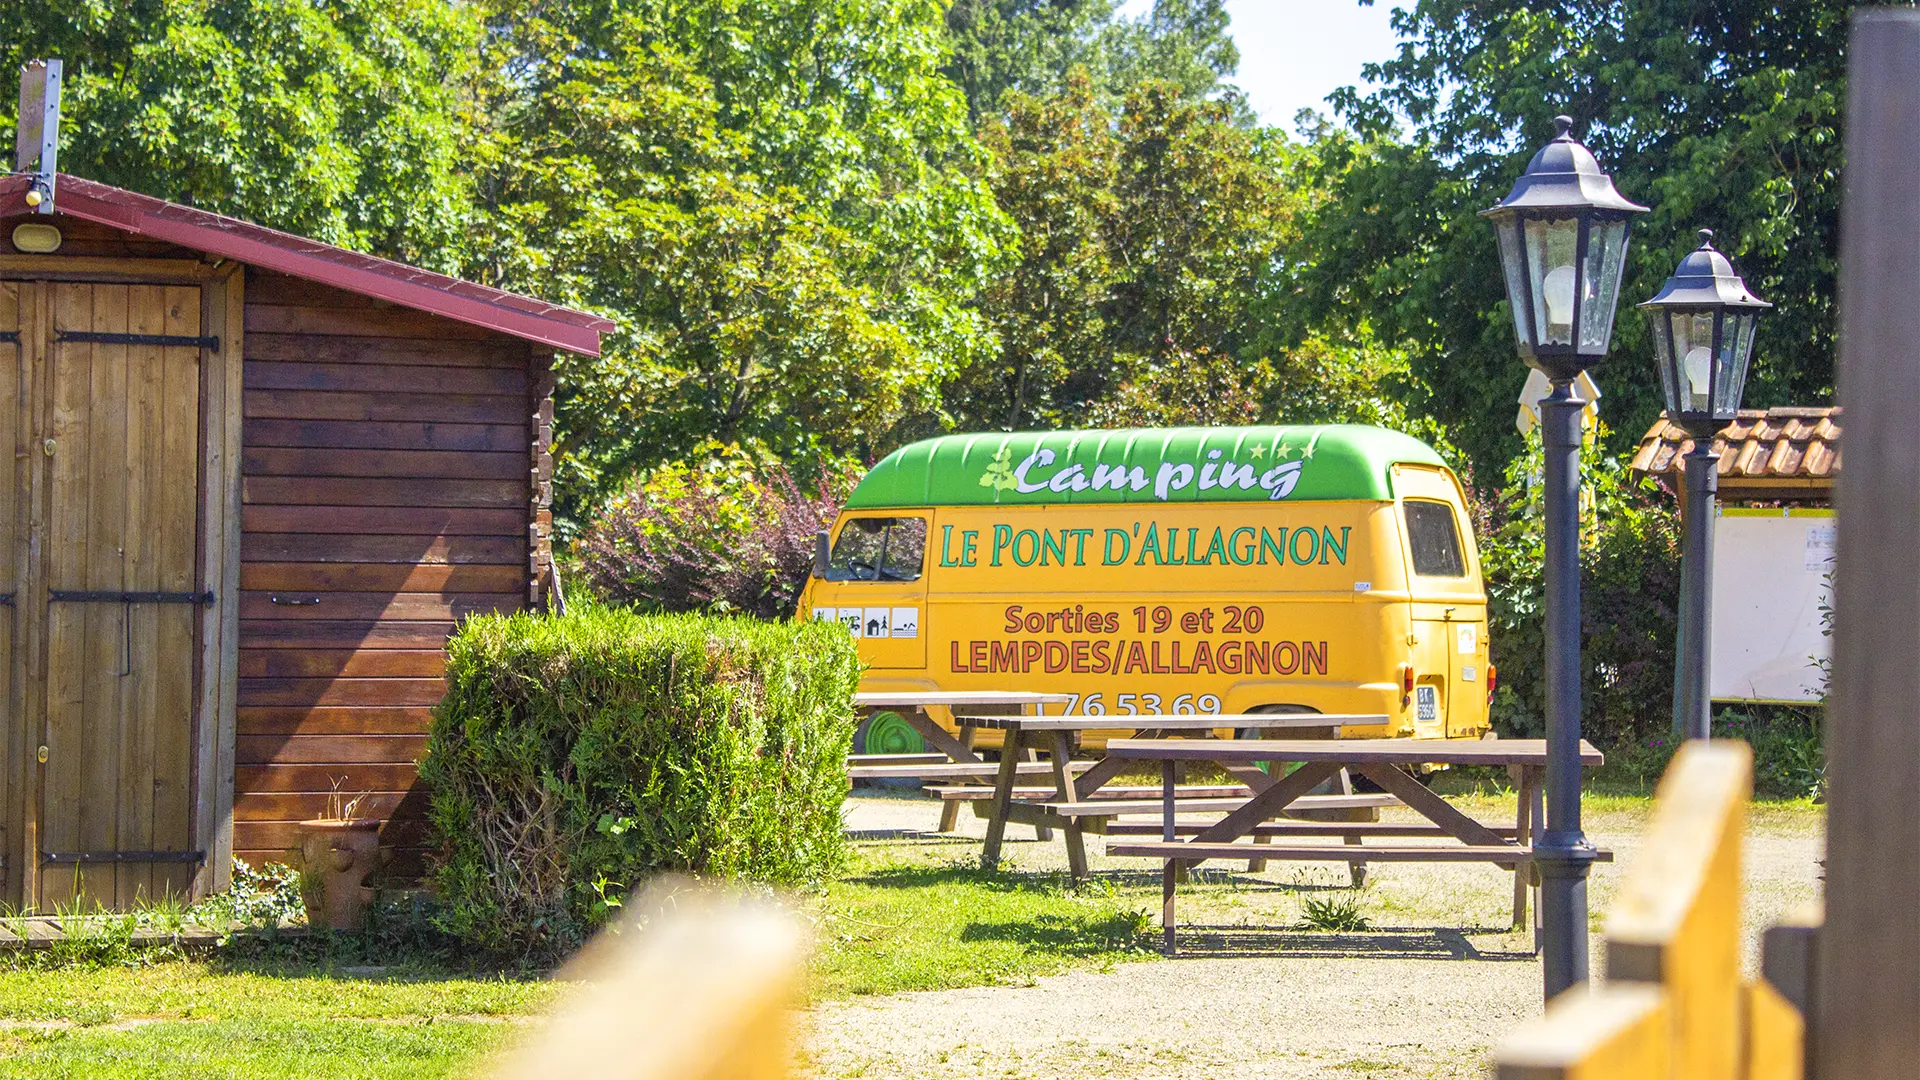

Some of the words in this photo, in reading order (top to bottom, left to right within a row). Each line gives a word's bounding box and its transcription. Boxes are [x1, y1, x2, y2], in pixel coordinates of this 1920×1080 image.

[1013, 448, 1304, 501] Camping
[1004, 605, 1120, 633] Sorties
[1133, 606, 1172, 634] 19
[1180, 607, 1214, 634] et
[1221, 606, 1264, 634] 20
[950, 640, 1328, 675] LEMPDES/ALLAGNON
[1116, 693, 1163, 716] 53
[1171, 694, 1222, 716] 69
